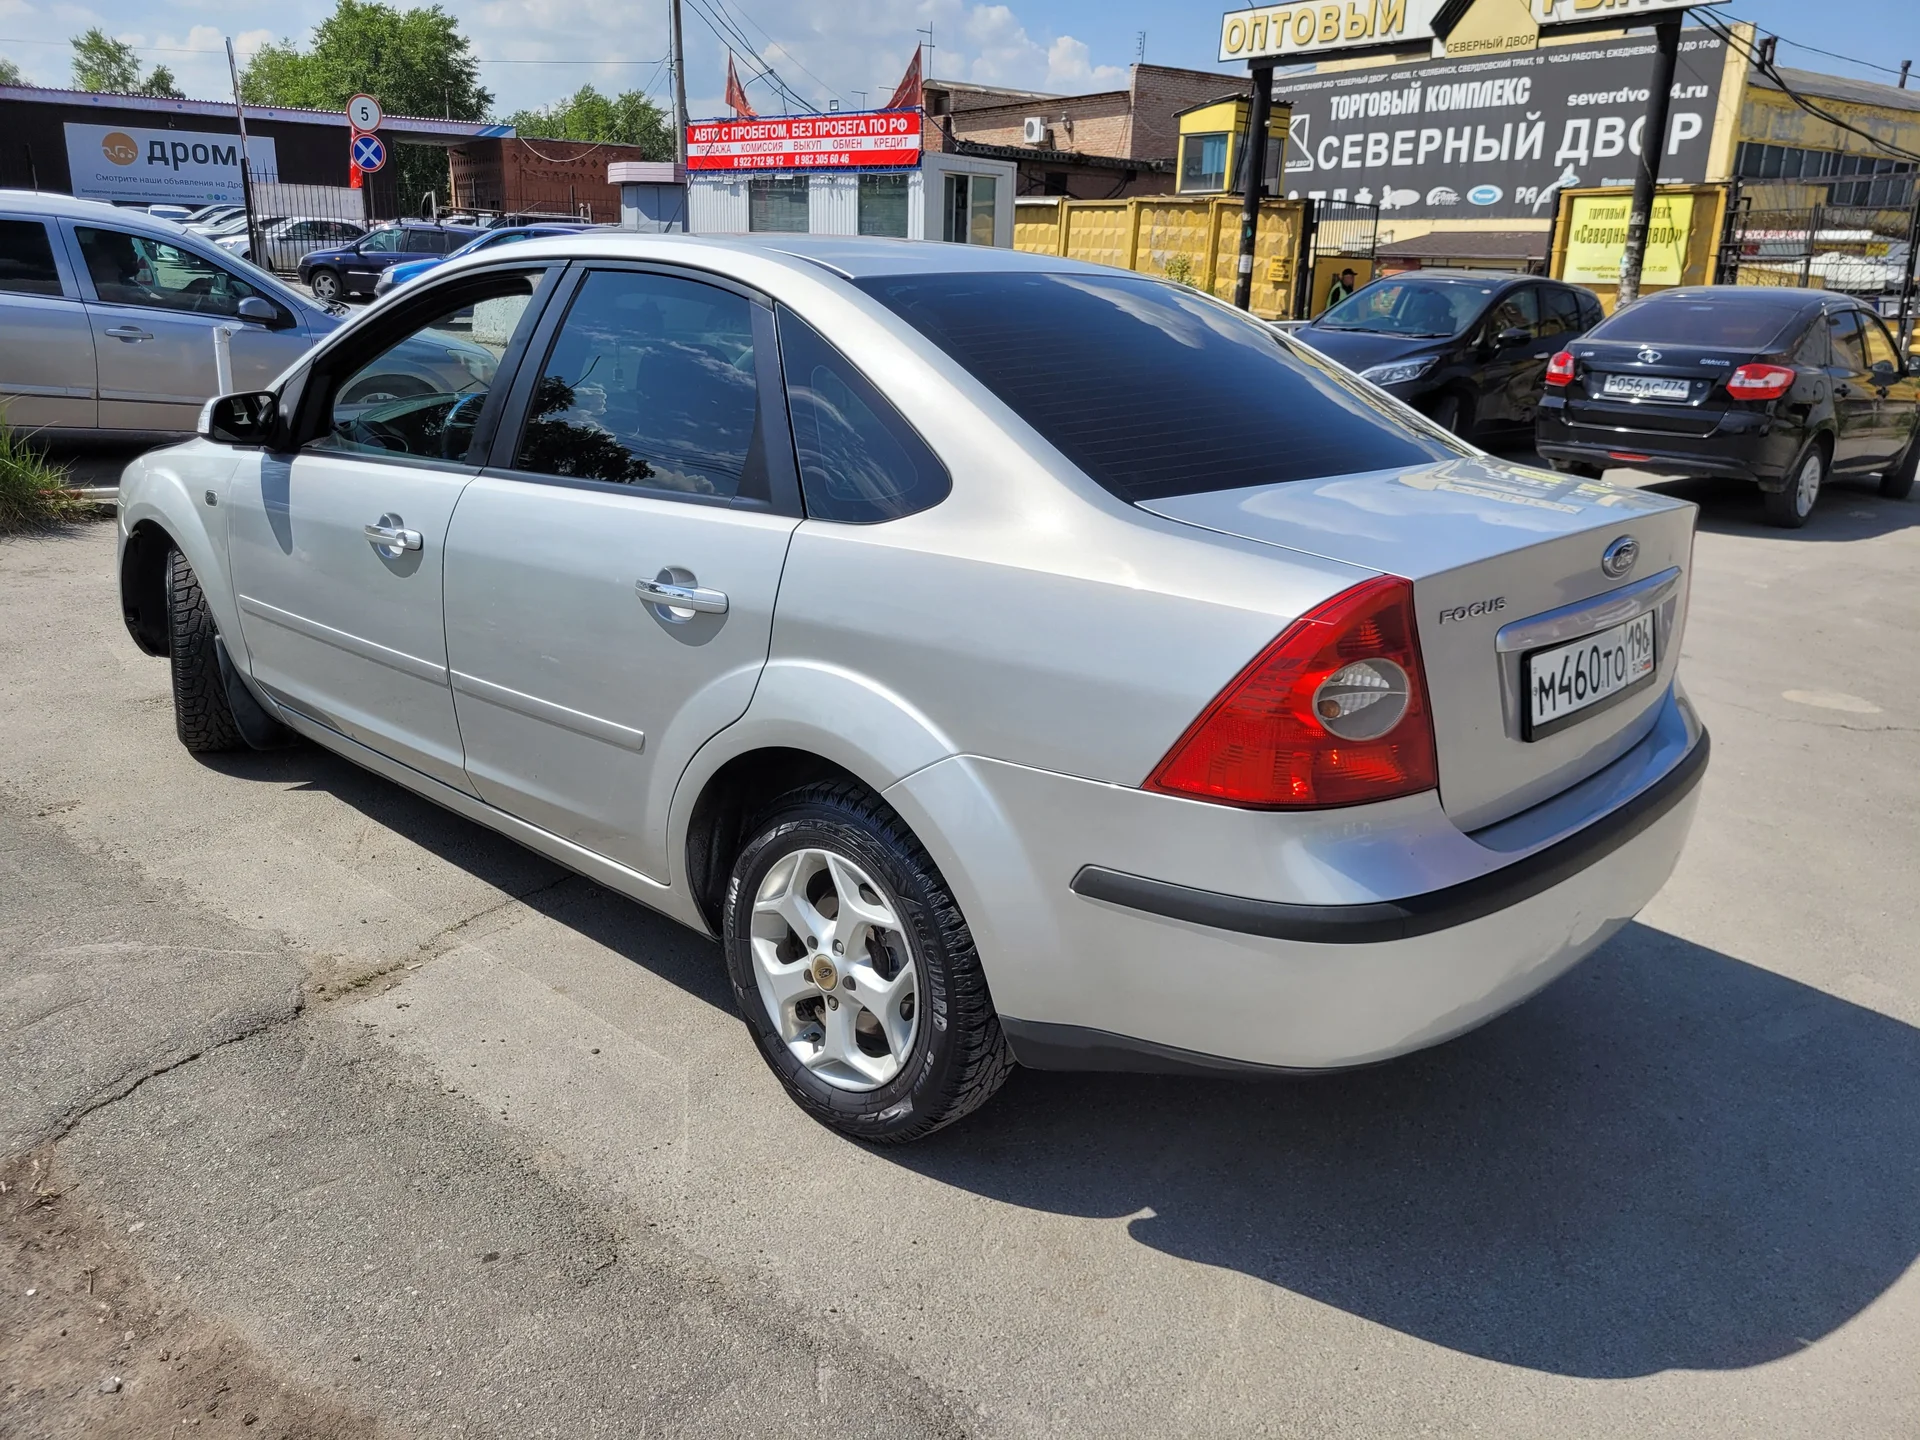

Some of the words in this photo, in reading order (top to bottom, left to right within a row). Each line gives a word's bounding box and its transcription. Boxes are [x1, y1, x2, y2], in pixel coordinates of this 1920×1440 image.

[1224, 0, 1407, 54] ОПТОВЫЙ
[1446, 36, 1503, 54] СЕВЕРНЫЙ
[1506, 34, 1536, 48] ДВОР
[1548, 52, 1571, 64] ЧАСЫ
[1606, 44, 1657, 58] ЕЖЕДНЕВНО
[1683, 41, 1697, 52] ДО
[1330, 81, 1422, 122] ТОРГОВЫЙ
[1425, 77, 1532, 112] КОМПЛЕКС
[1567, 82, 1709, 107] severdvo4.ru
[360, 106, 369, 122] 5
[693, 127, 719, 141] АВТО
[721, 126, 729, 139] С
[731, 124, 789, 139] ПРОБЕГОМ,
[792, 122, 812, 137] БЕЗ
[816, 119, 866, 136] ПРОБЕГА
[869, 118, 887, 133] ПО
[889, 117, 908, 132] РФ
[1317, 110, 1546, 171] СЕВЕРНЫЙ
[147, 139, 238, 172] дром
[696, 143, 731, 154] ПРОДАЖА
[741, 142, 783, 153] КОМИССИЯ
[793, 140, 822, 151] ВЫКУП
[832, 138, 862, 149] ОБМЕН
[874, 136, 909, 148] КРЕДИТ
[733, 157, 739, 167] 8
[739, 156, 751, 166] 922
[753, 156, 765, 165] 712
[776, 155, 784, 165] 12
[794, 155, 800, 165] 8
[815, 154, 828, 164] 305
[840, 153, 850, 163] 46
[95, 173, 138, 184] Смотрите
[139, 176, 162, 185] наши
[163, 177, 214, 188] объявления
[227, 181, 244, 190] Дро
[1588, 205, 1626, 220] ТОРГОВЫЙ
[1439, 596, 1507, 625] FOCUS
[1538, 645, 1626, 716] М460ТО
[1627, 618, 1650, 661] 196
